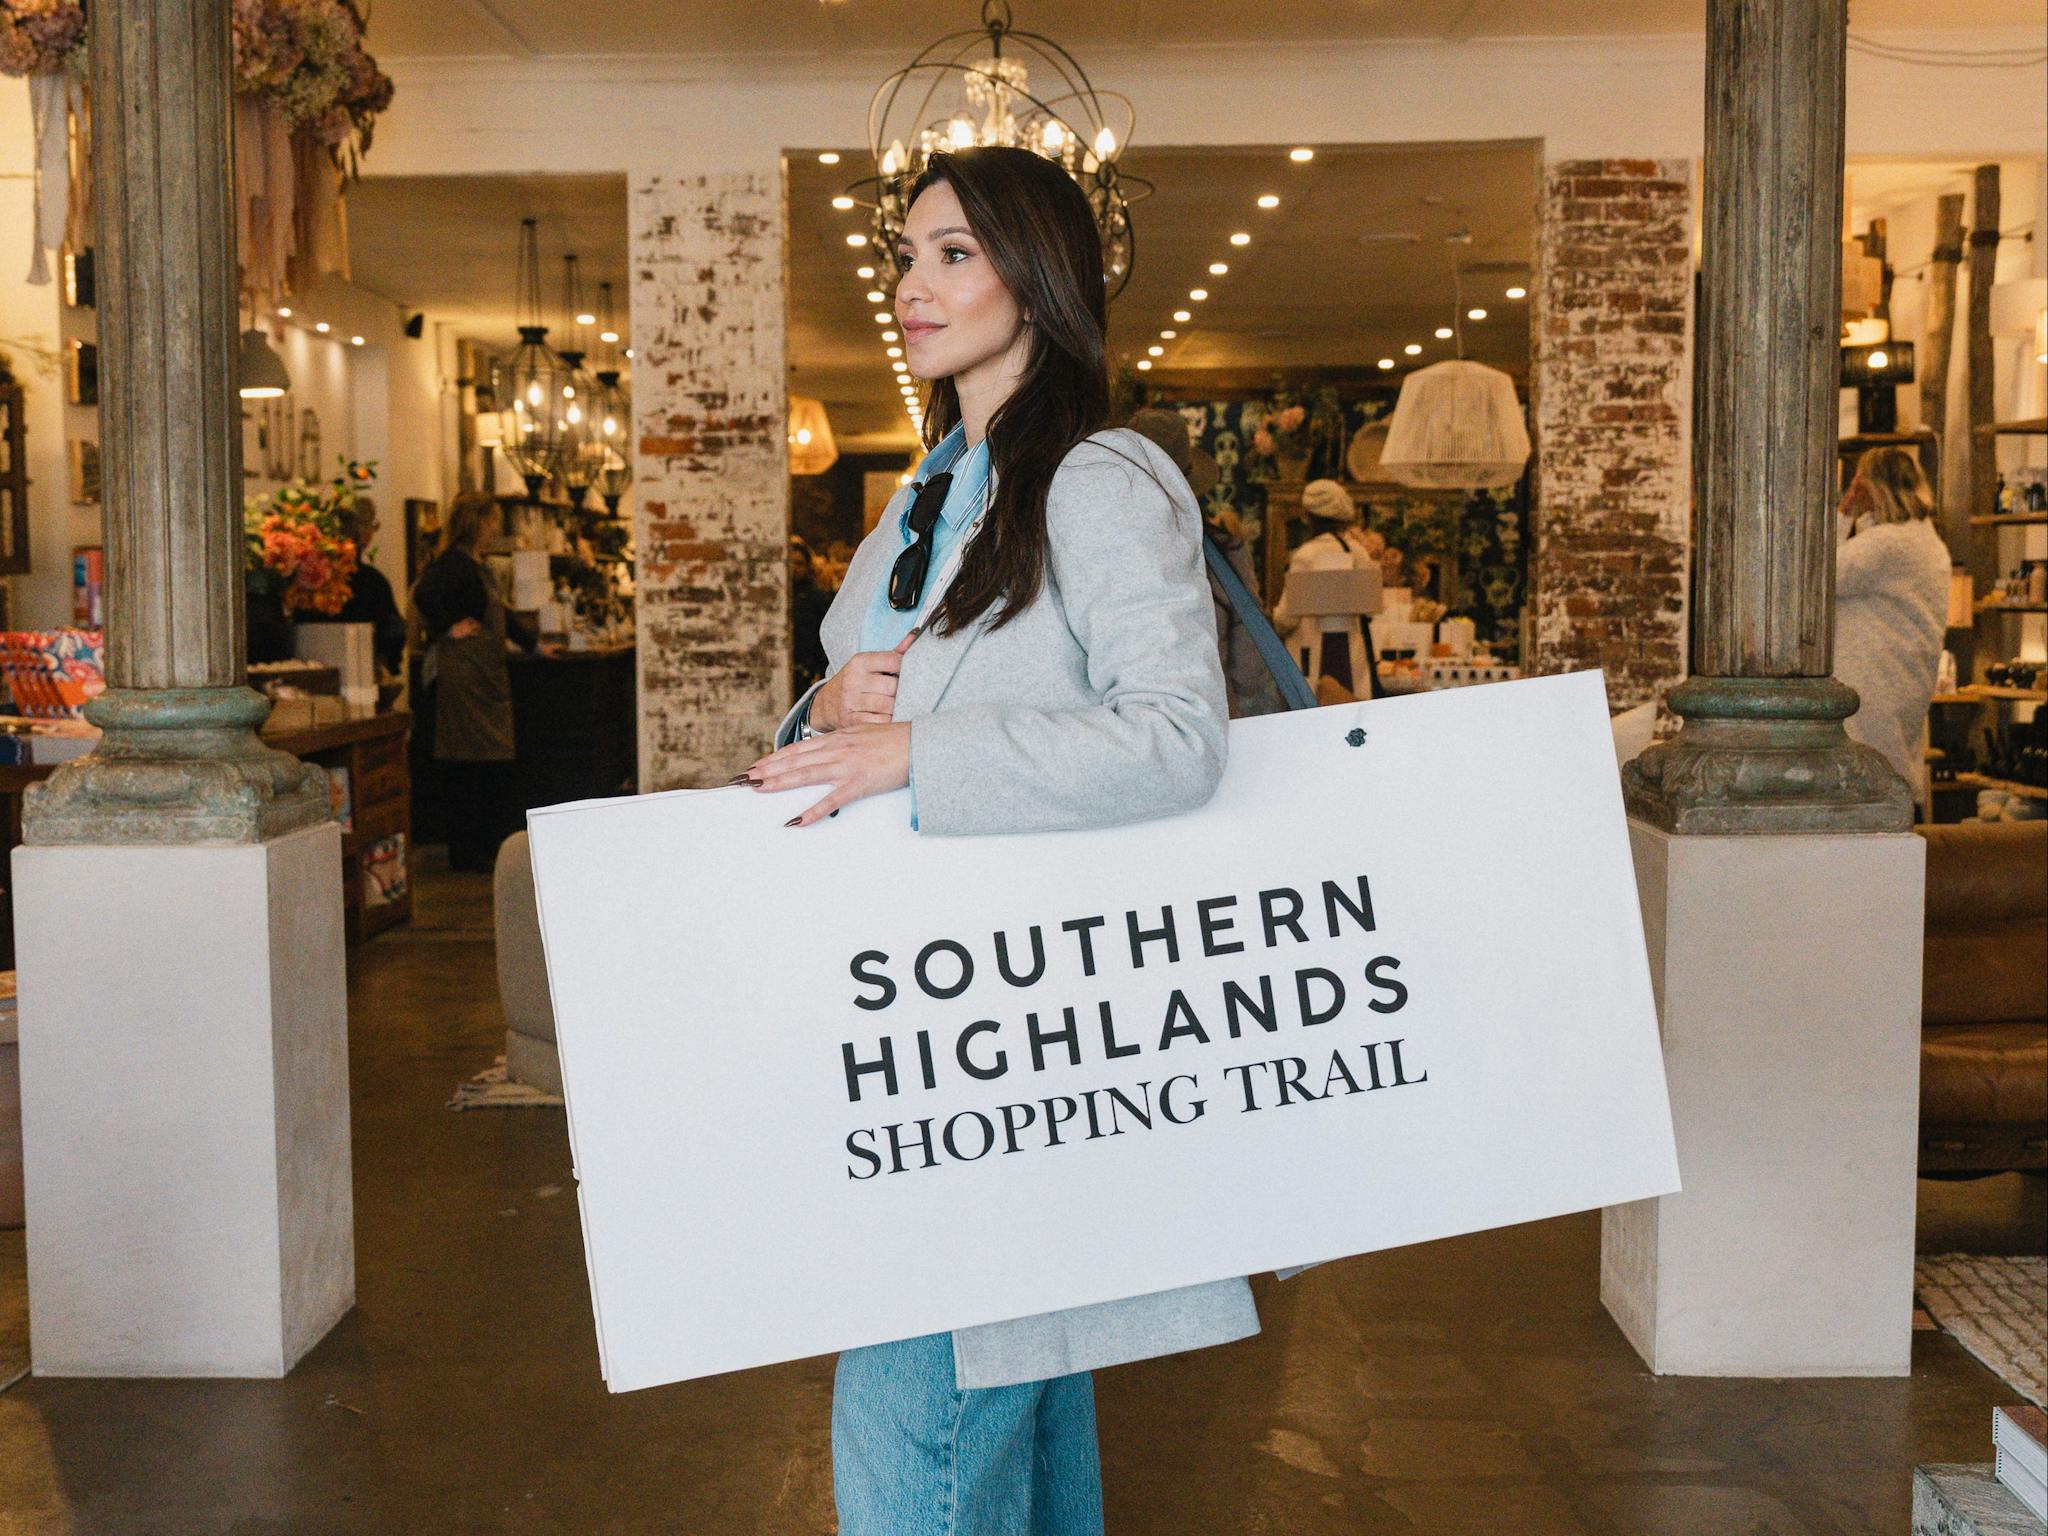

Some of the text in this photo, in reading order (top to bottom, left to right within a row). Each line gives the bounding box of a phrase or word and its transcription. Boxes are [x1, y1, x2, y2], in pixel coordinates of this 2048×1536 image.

[850, 875, 1377, 1010] SOUTHERN
[842, 956, 1408, 1102] HIGHLANDS
[846, 1038, 1428, 1179] SHOPPING TRAIL
